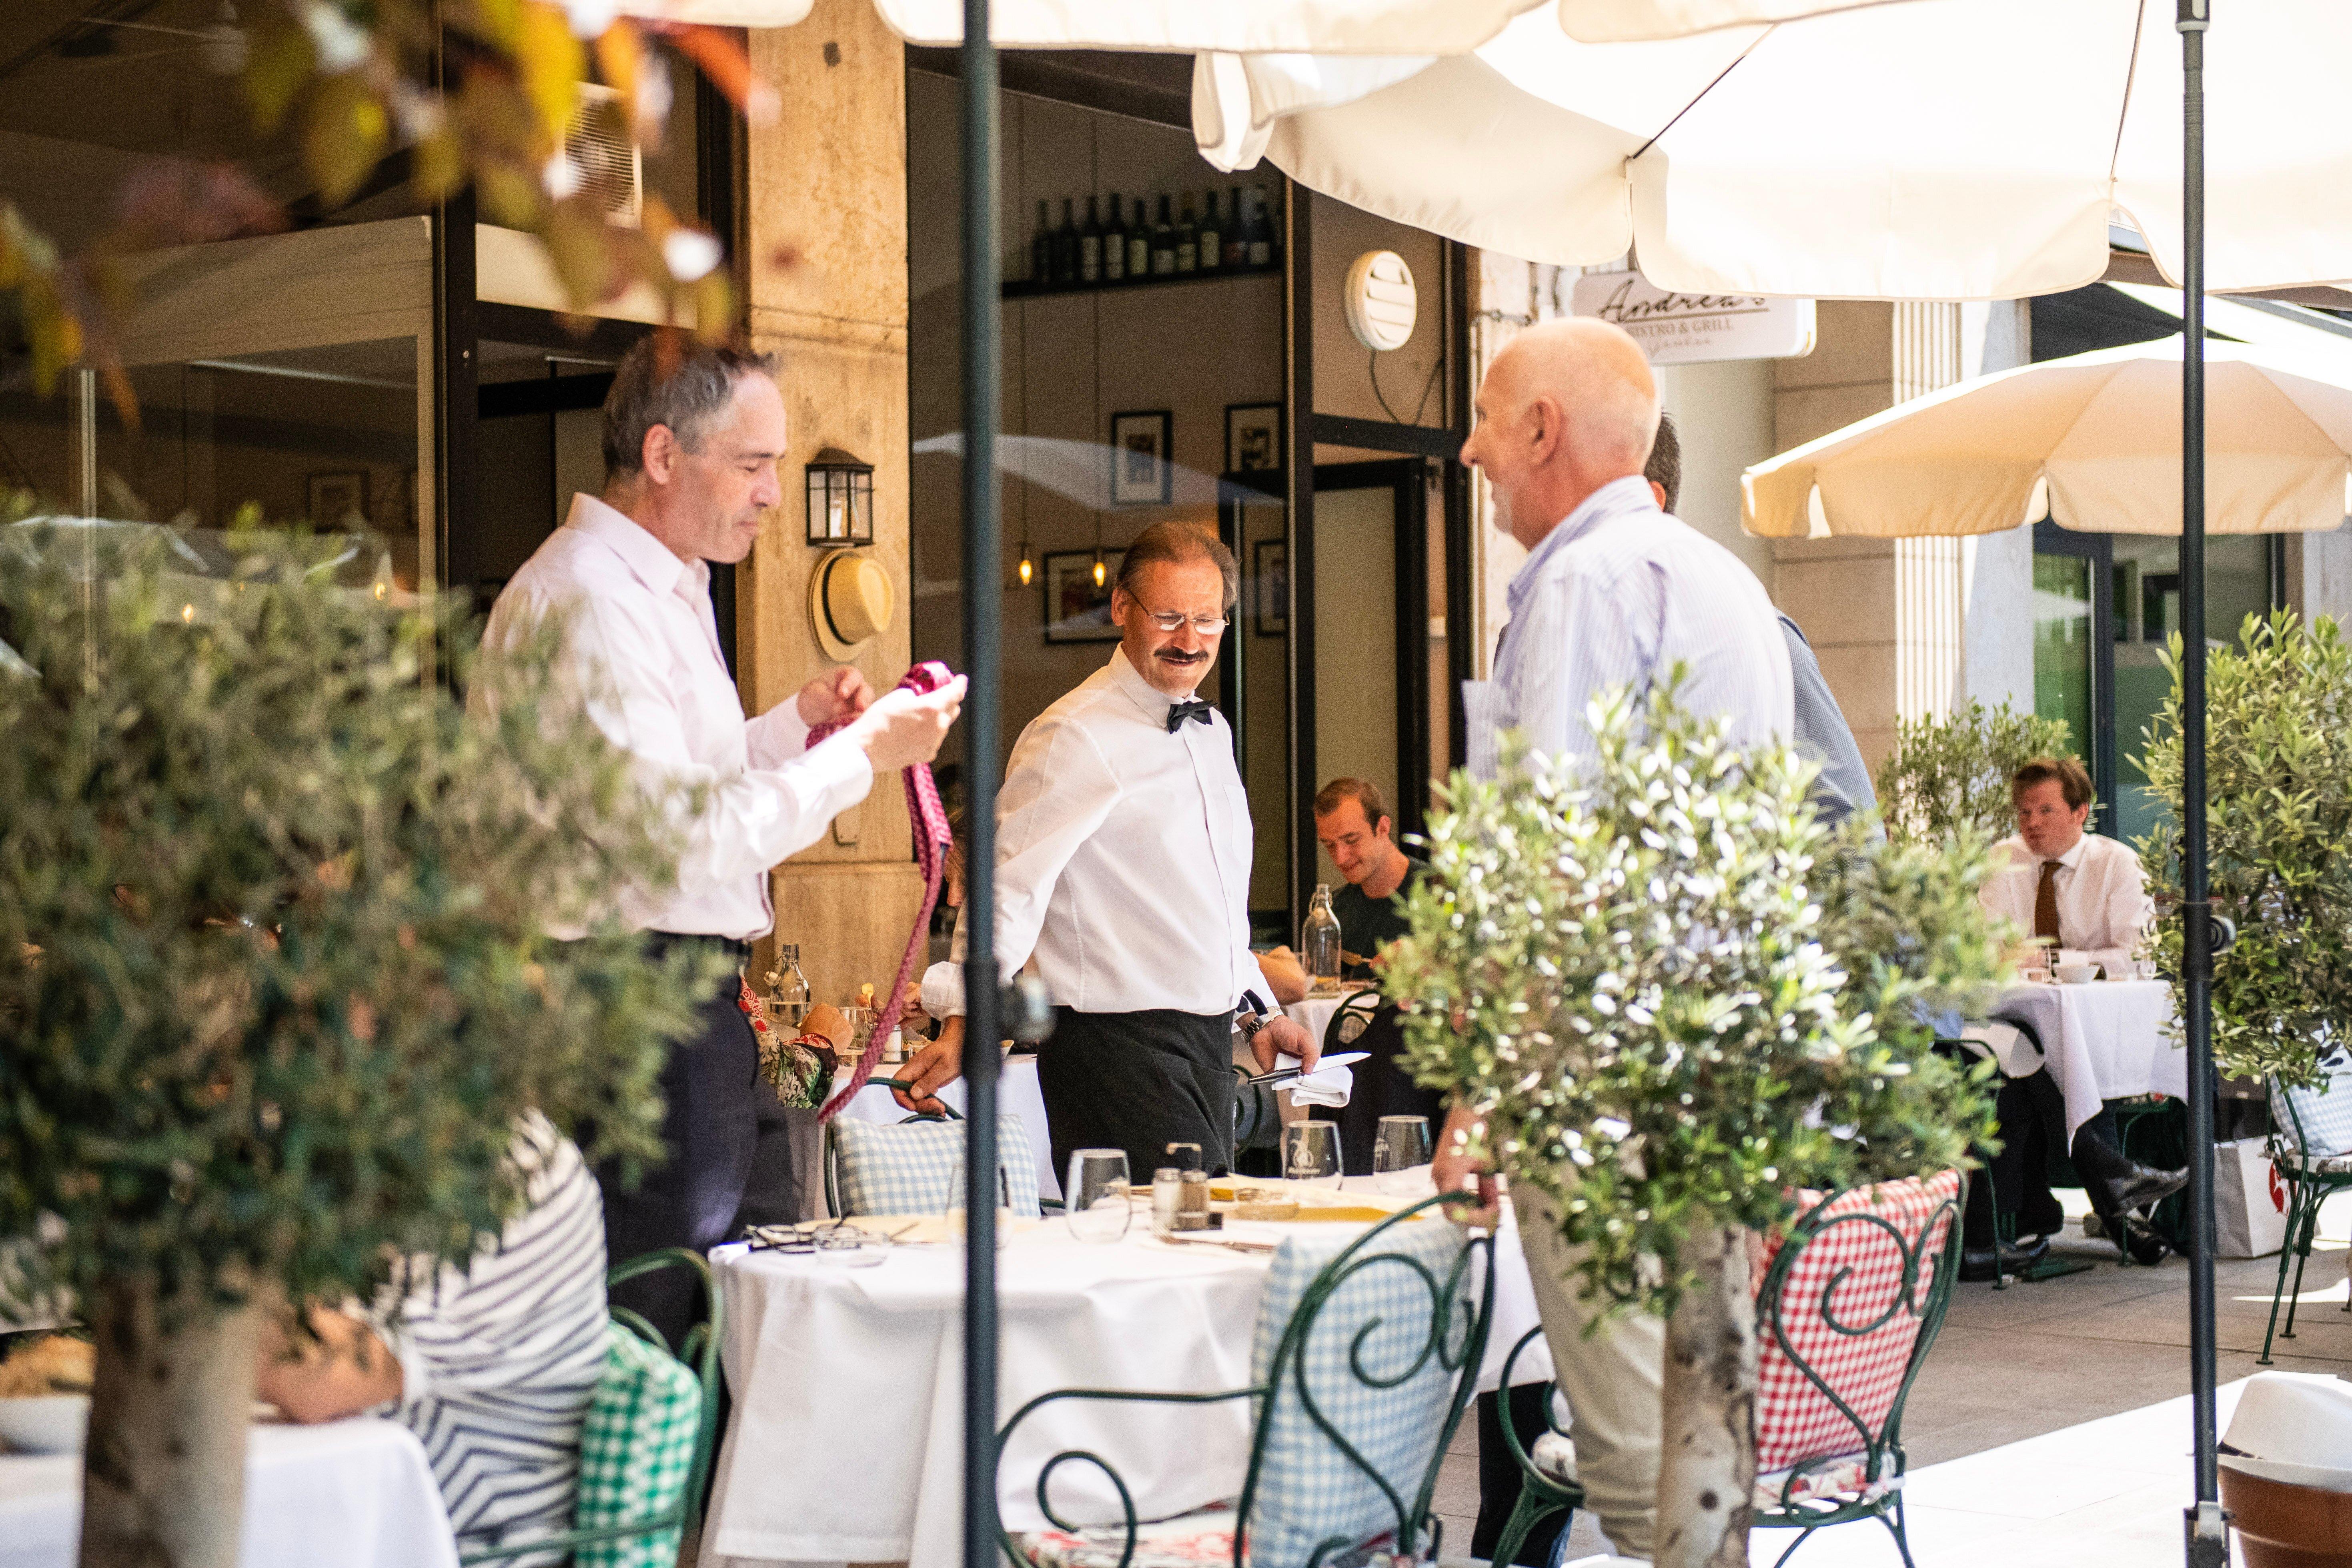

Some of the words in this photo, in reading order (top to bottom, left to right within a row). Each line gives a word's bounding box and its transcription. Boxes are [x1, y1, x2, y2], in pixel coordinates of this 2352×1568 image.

[1596, 279, 1765, 322] Andreas
[1679, 320, 1689, 334] &
[1692, 317, 1734, 333] GRILL
